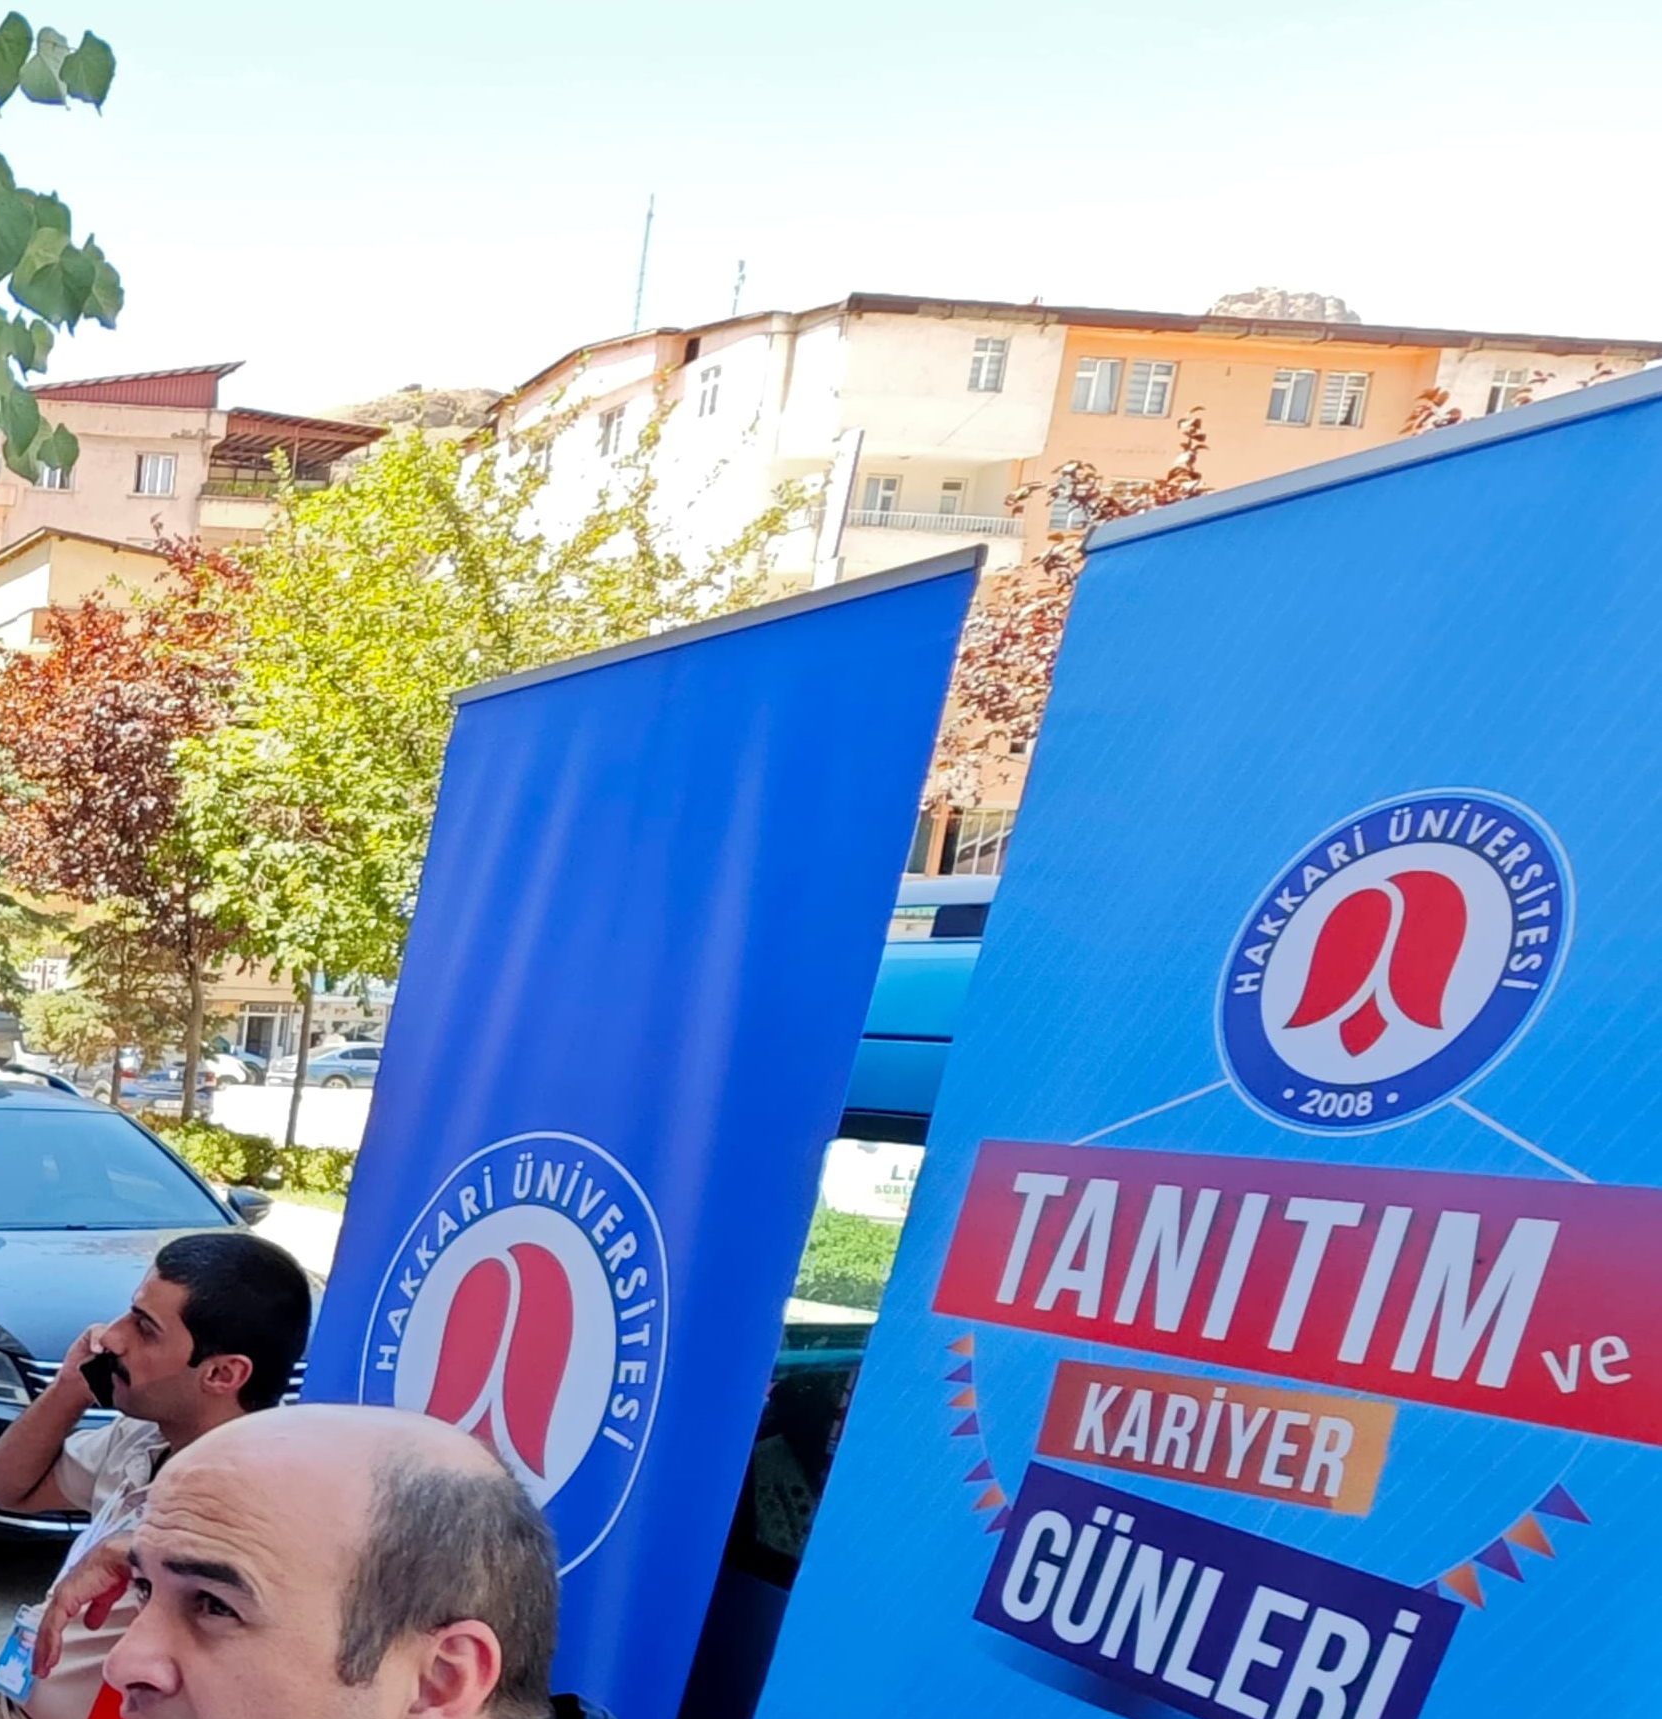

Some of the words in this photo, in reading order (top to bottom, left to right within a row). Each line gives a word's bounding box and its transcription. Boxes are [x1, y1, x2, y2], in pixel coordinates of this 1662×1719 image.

[1234, 825, 1368, 996] HAKKARİ
[1388, 802, 1558, 993] ÜNİVERSİTESİ
[1297, 1086, 1374, 1120] 2008
[376, 1165, 494, 1371] HAKKARİ
[513, 1152, 658, 1452] ÜNİVERSİTESİ
[995, 1171, 1560, 1390] TANITIM
[1541, 1334, 1632, 1395] ve
[1073, 1382, 1355, 1498] KARİYER
